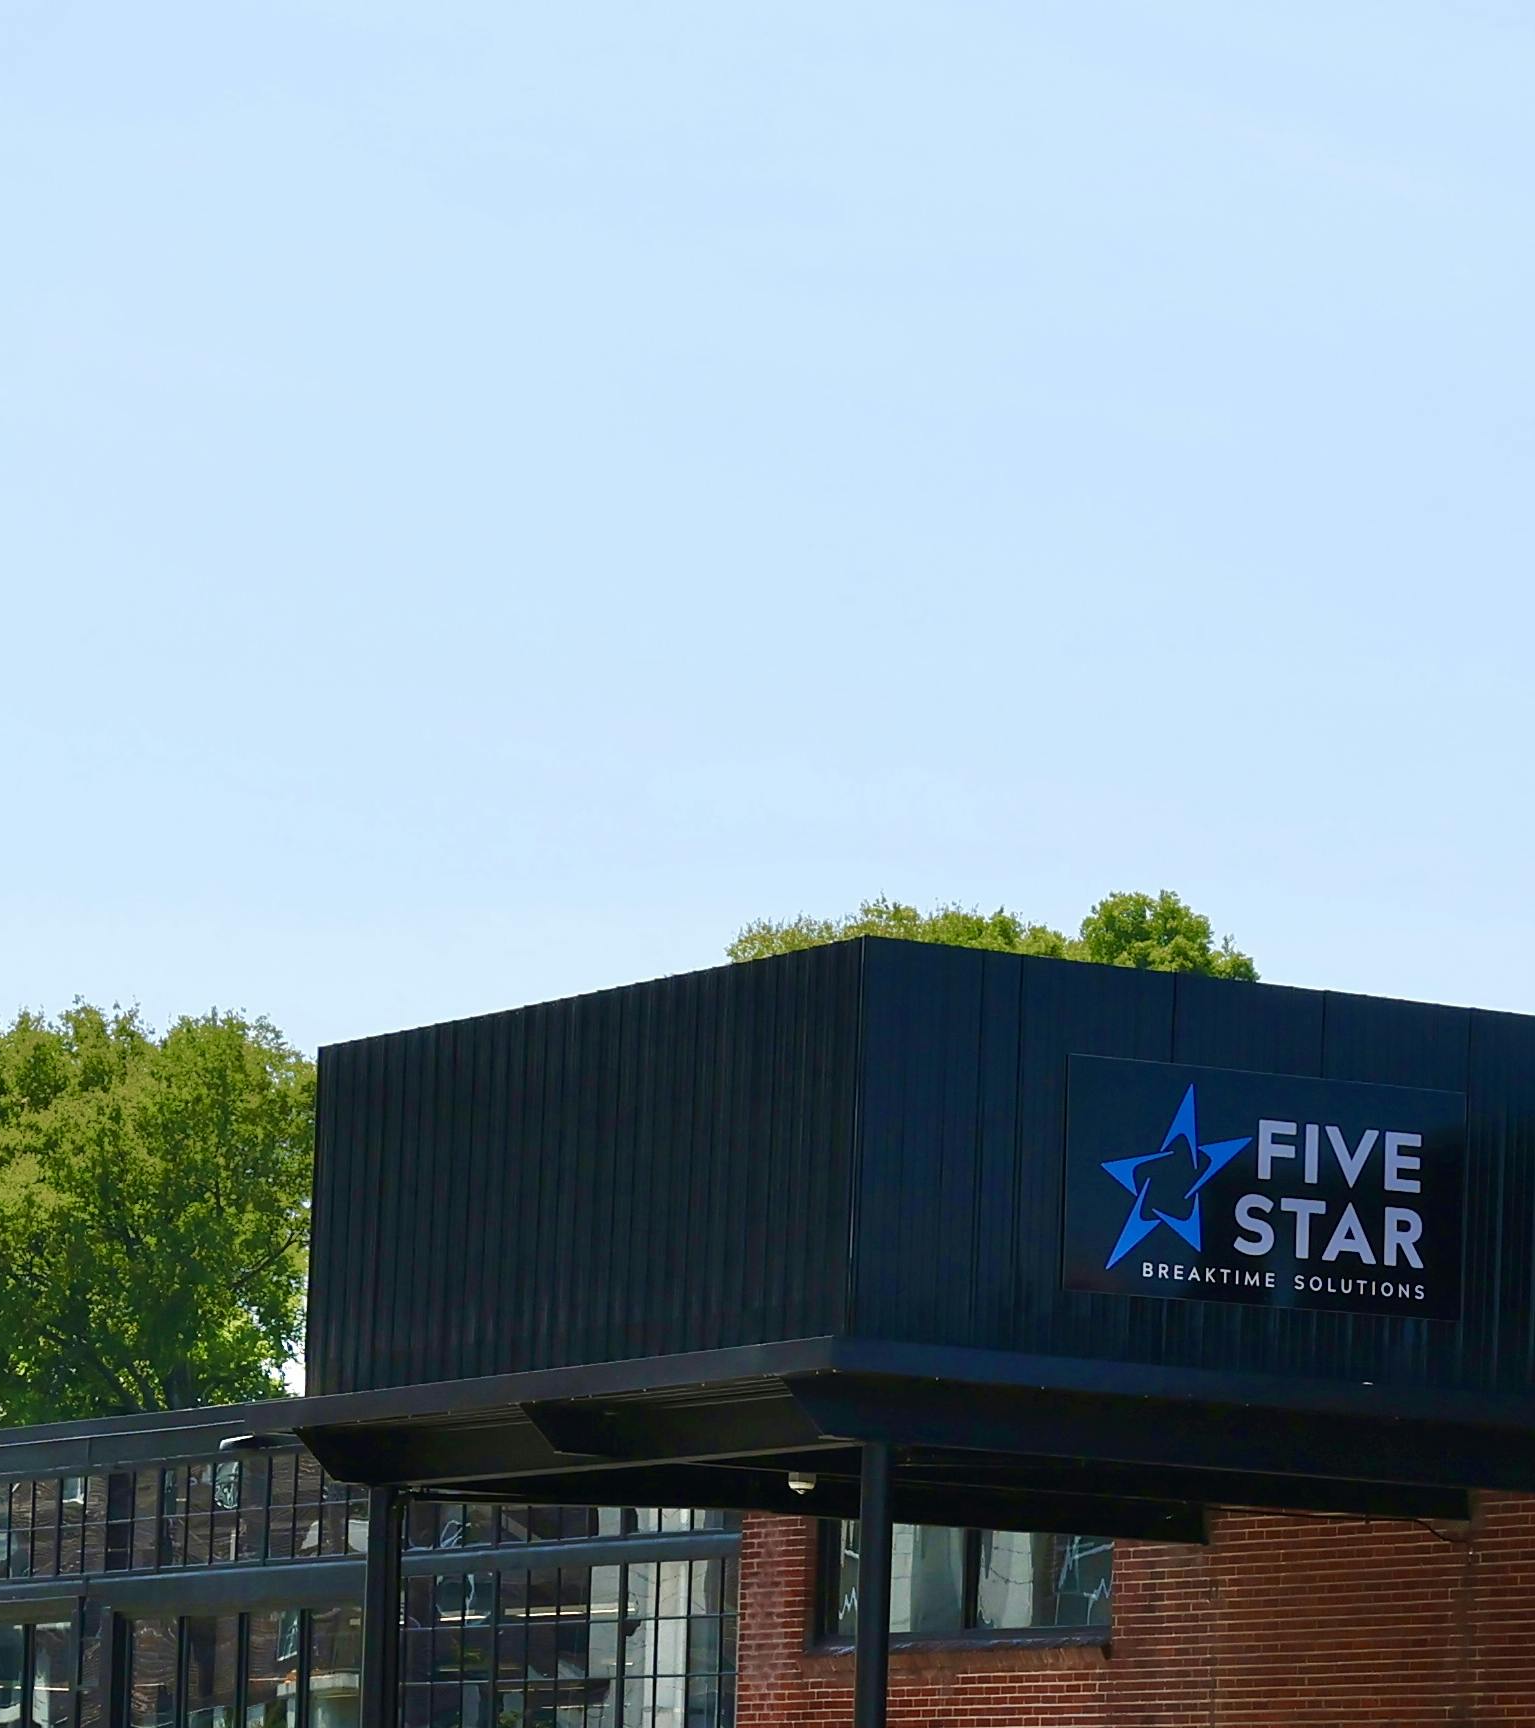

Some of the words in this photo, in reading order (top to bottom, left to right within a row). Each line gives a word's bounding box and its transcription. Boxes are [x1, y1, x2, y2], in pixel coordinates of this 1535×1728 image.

[1257, 1119, 1422, 1193] FIVE
[1233, 1193, 1424, 1269] STAR
[1142, 1262, 1275, 1288] BREAKTIME
[1294, 1274, 1425, 1300] SOLUTIONS
